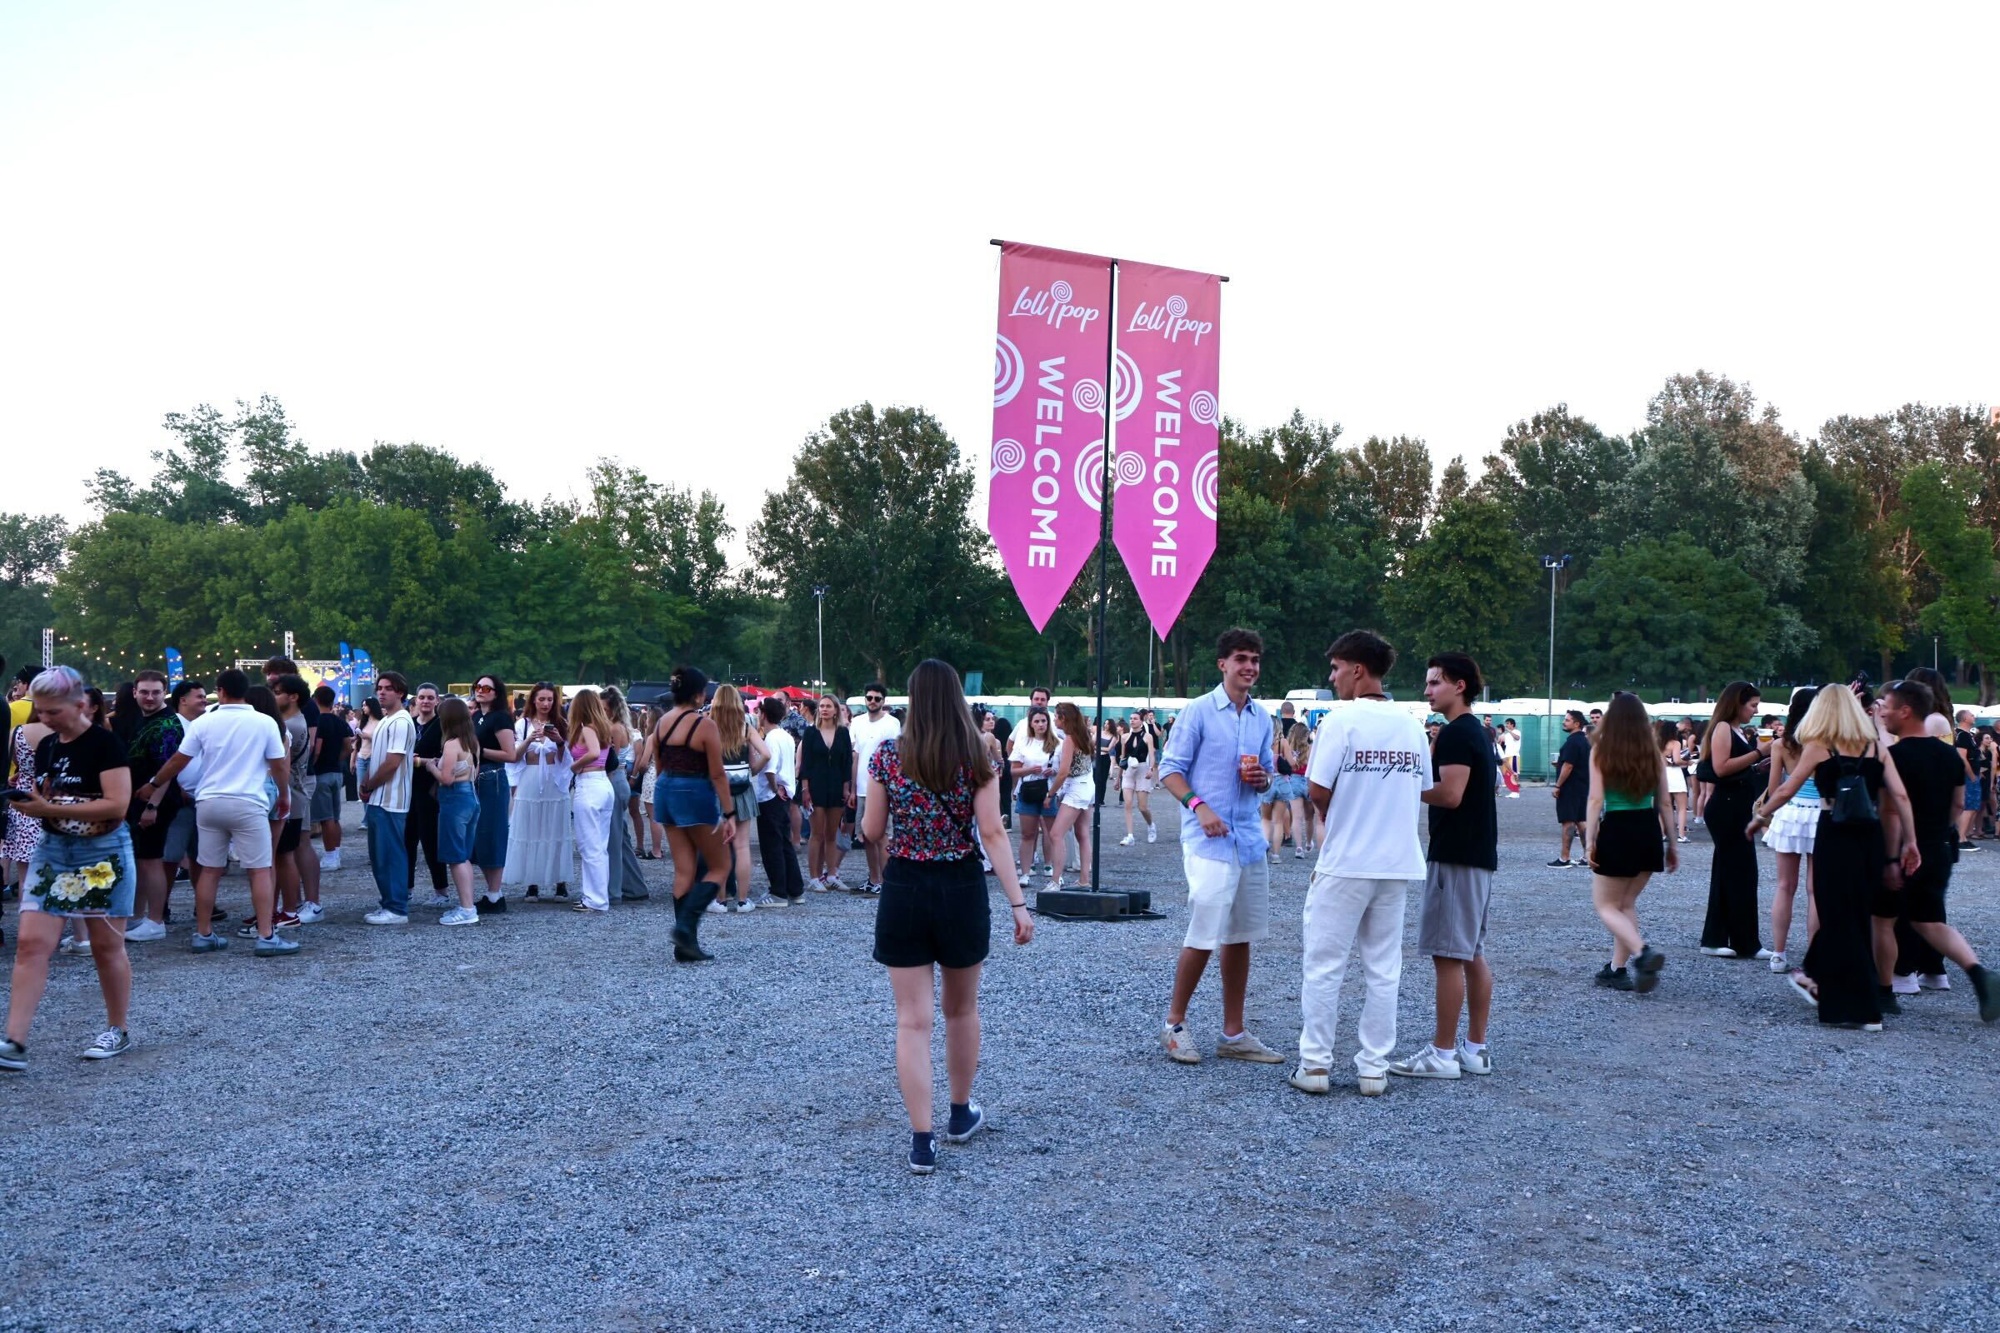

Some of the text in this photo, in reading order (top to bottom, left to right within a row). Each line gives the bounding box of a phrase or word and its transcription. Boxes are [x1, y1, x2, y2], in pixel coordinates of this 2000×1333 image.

[1008, 280, 1099, 332] Lollipop
[1126, 295, 1213, 345] Lollipop
[1028, 355, 1066, 569] WELCOME
[1151, 369, 1182, 577] WELCOME
[1343, 762, 1380, 773] Patron
